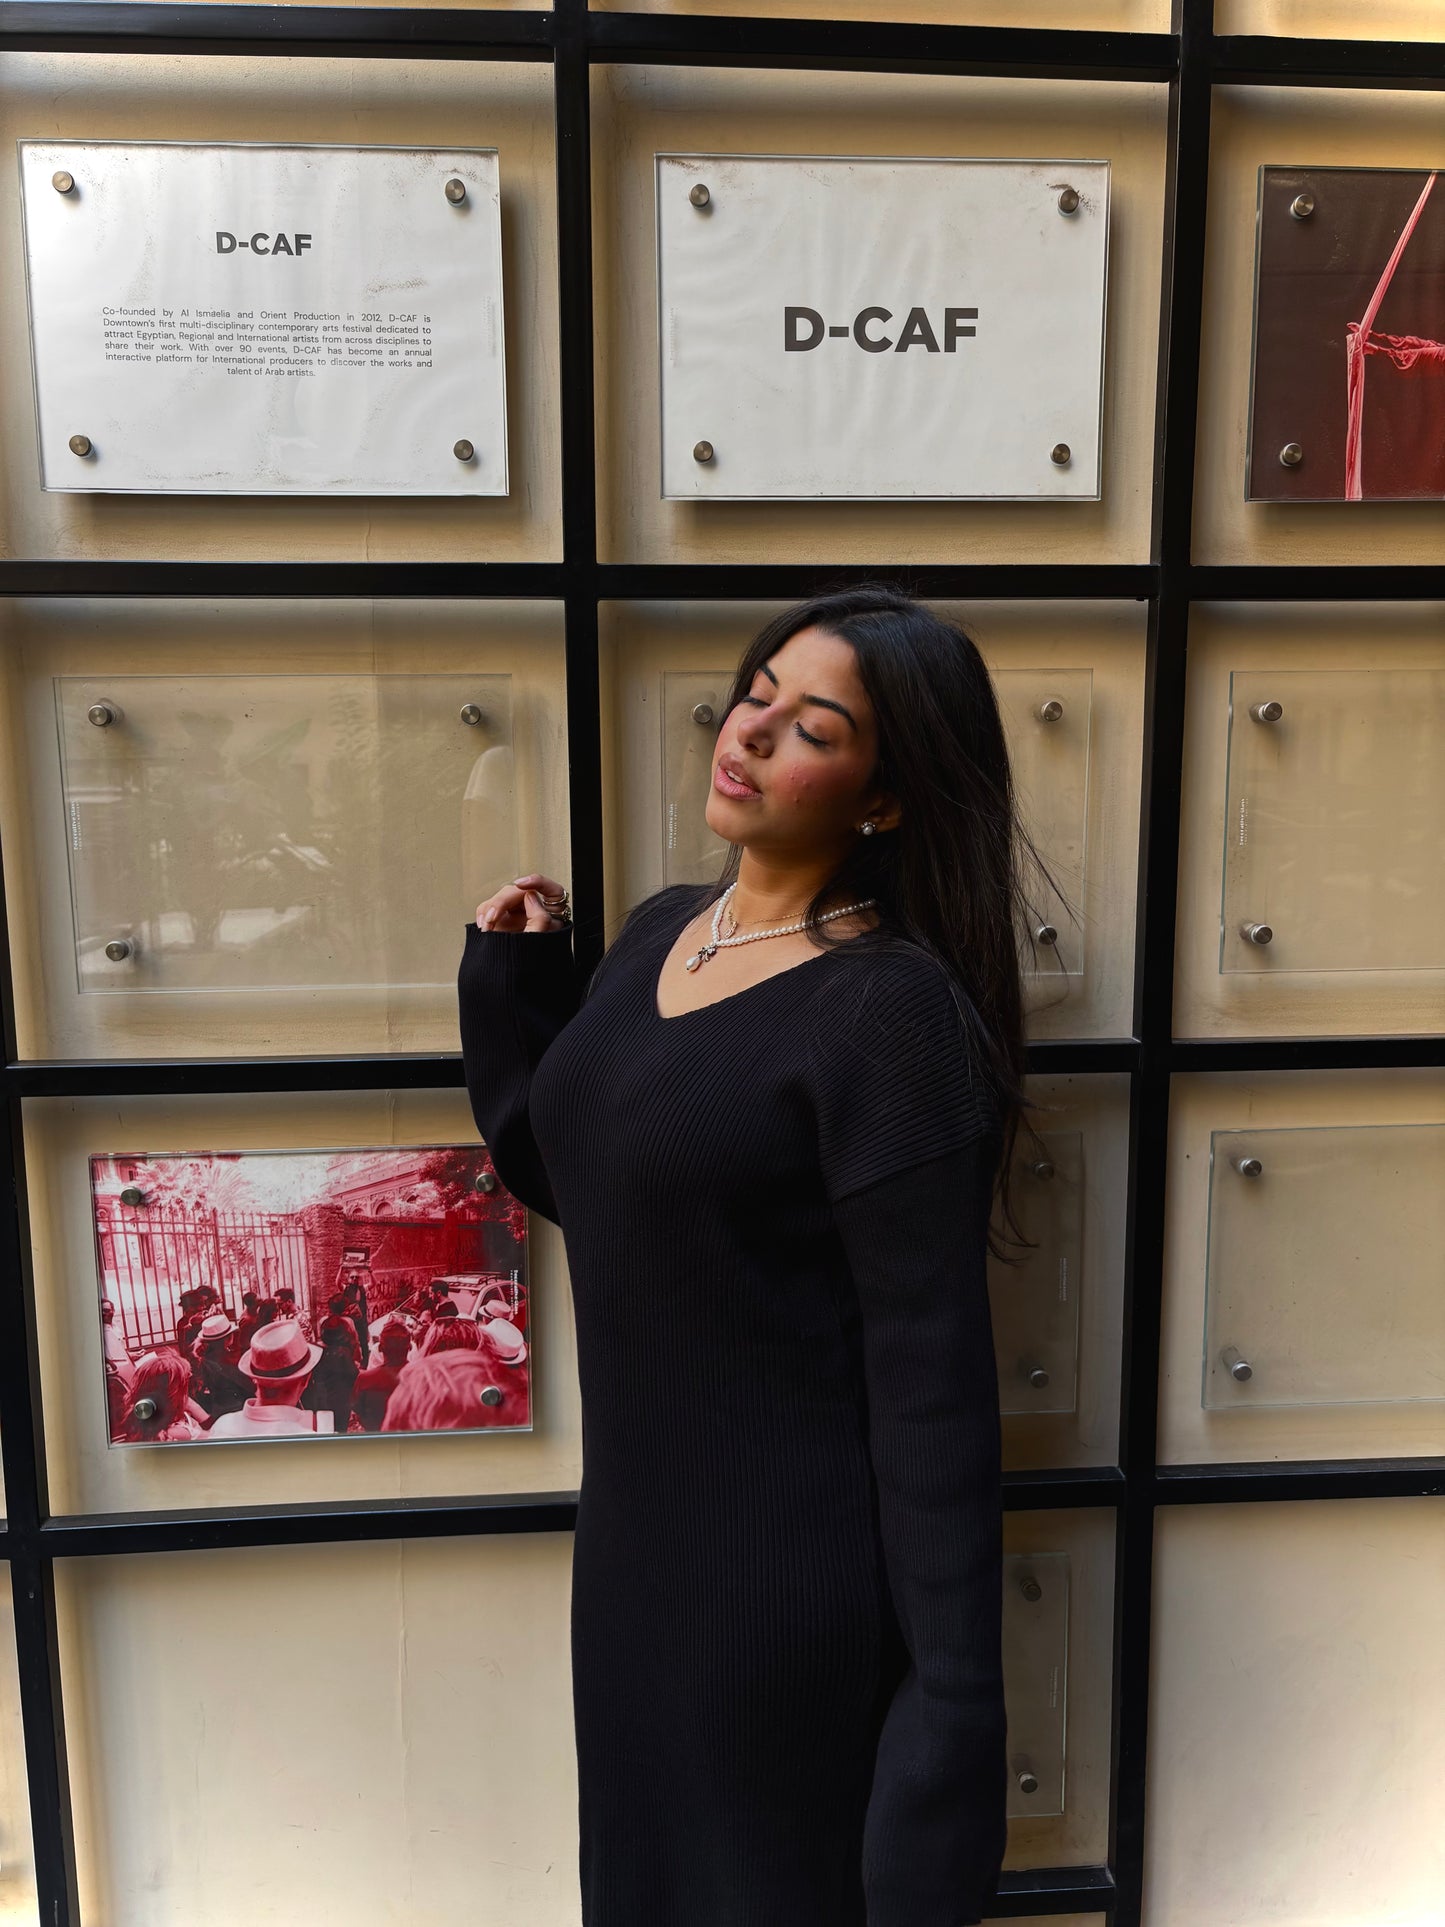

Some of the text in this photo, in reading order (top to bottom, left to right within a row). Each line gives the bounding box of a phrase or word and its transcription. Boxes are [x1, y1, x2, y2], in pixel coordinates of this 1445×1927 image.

[216, 232, 312, 256] D-CAF
[103, 306, 430, 323] Co-founded by Al Ismaelia and Orient Production in 2012, D-CAF is
[104, 317, 431, 334] Downtown's first multi-disciplinary contemporary arts festival dedicated to
[785, 306, 978, 353] D-CAF
[105, 329, 431, 347] attract Egyptian, Regional and International artists from across disciplines to
[105, 340, 128, 349] share
[135, 341, 154, 350] their
[161, 342, 183, 350] work.
[189, 342, 209, 351] With
[240, 343, 251, 351] 90
[258, 343, 287, 355] events,
[294, 344, 322, 354] D-CAF
[328, 345, 342, 354] has
[348, 345, 382, 355] become
[405, 346, 431, 356] annual
[106, 352, 432, 367] interactive platform for International producers to discover the works and
[228, 366, 315, 377] talent of Arab artists.
